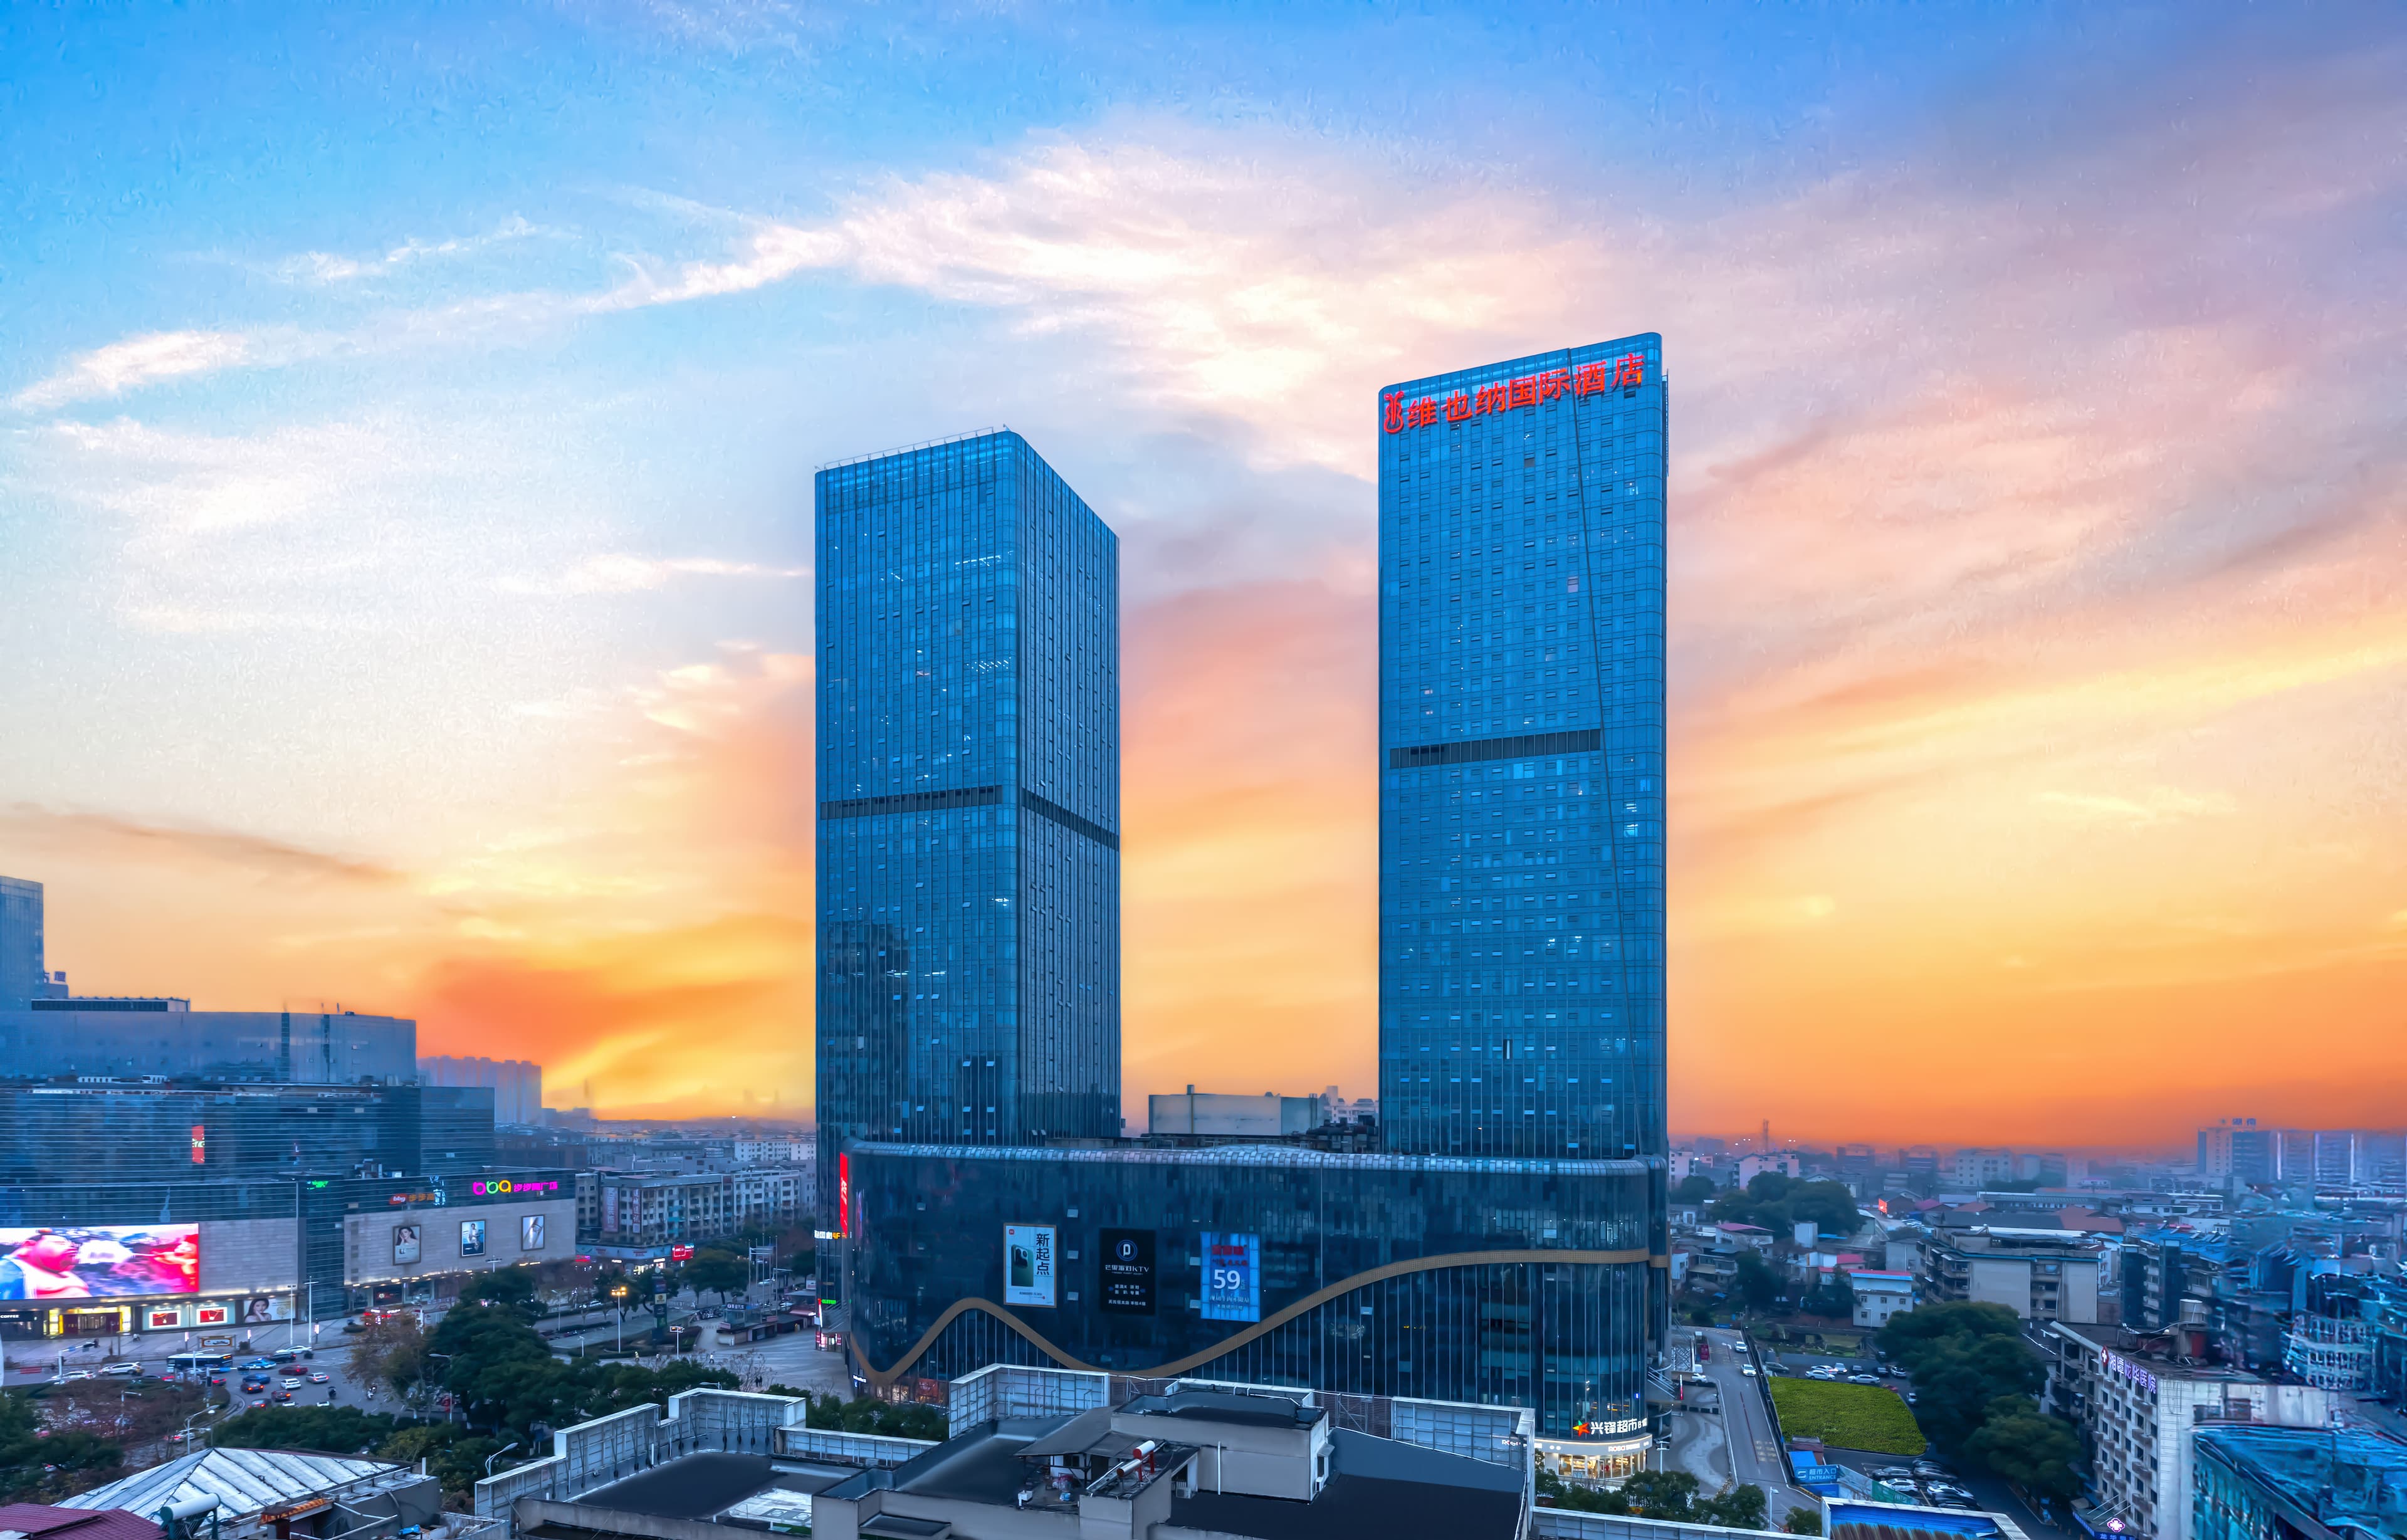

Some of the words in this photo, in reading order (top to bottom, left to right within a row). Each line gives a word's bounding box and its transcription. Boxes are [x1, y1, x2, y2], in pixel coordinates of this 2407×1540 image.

[1407, 353, 1645, 428] 维也纳国际酒店
[1036, 1233, 1050, 1275] 新起点
[1214, 1269, 1240, 1290] 59
